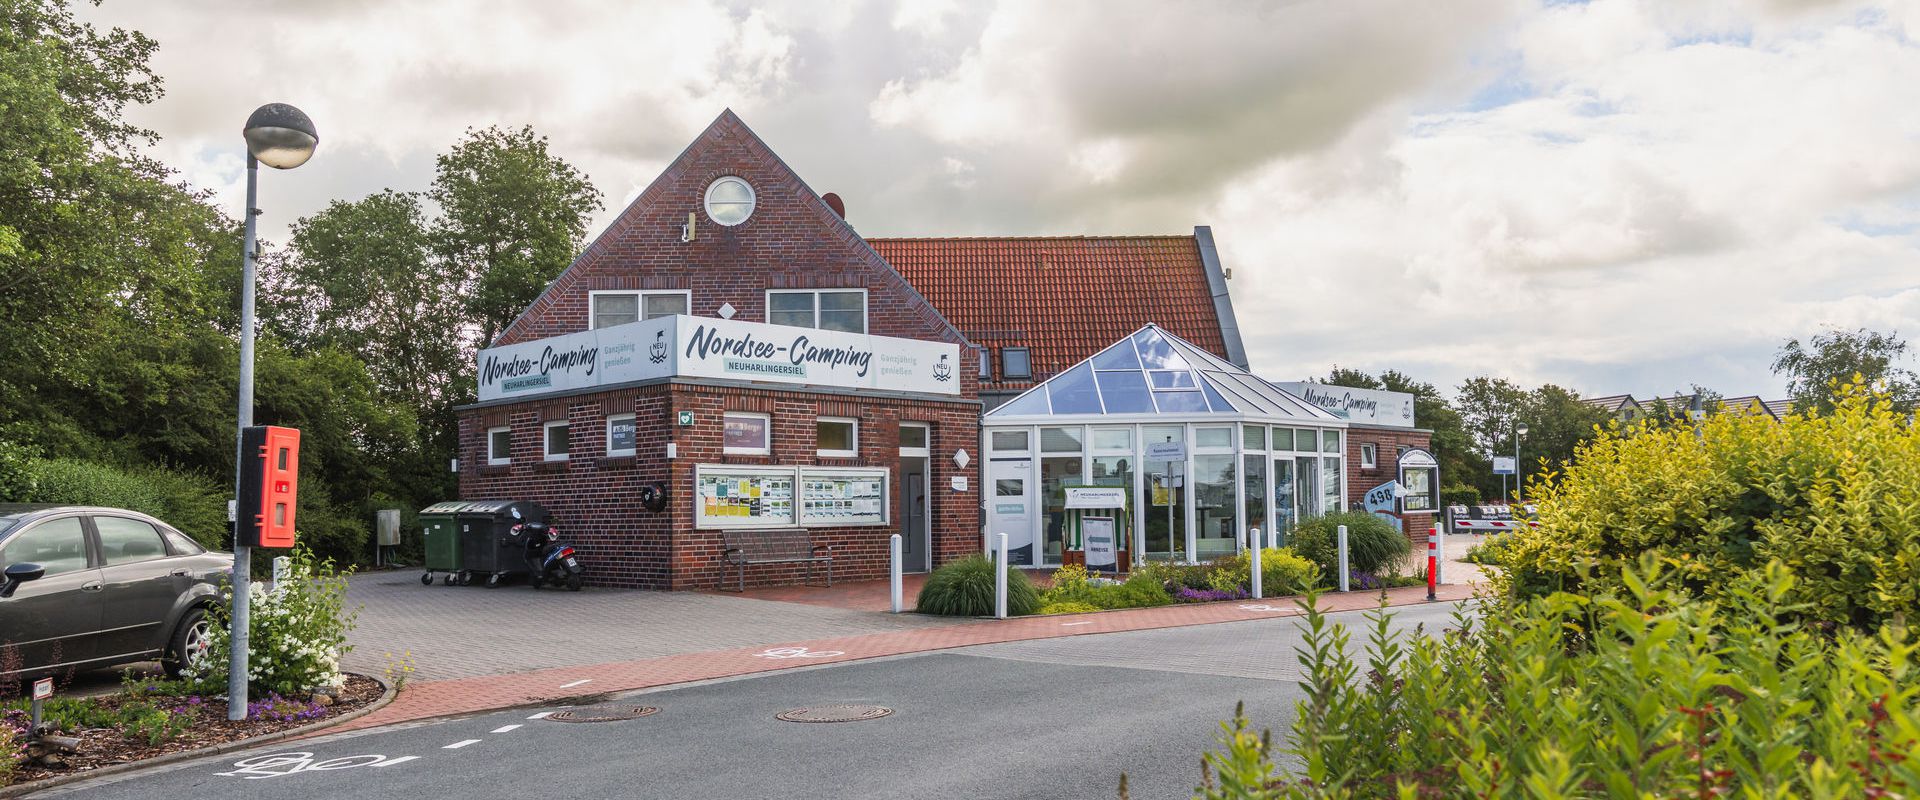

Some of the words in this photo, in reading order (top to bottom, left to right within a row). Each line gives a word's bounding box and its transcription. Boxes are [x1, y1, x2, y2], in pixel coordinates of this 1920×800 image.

[604, 342, 635, 355] Ganzjährig
[686, 324, 872, 378] Nordsee-Camping
[482, 345, 598, 386] Nordsee-Camping
[604, 357, 631, 369] genießen
[880, 353, 917, 366] Ganzjährig
[728, 361, 804, 375] NEUHARLINGERSIEL
[881, 366, 912, 376] genießen
[504, 378, 550, 391] NEUHARLINGERSIEL
[1304, 388, 1377, 418] Nordsee-Camping
[1370, 488, 1393, 505] 498
